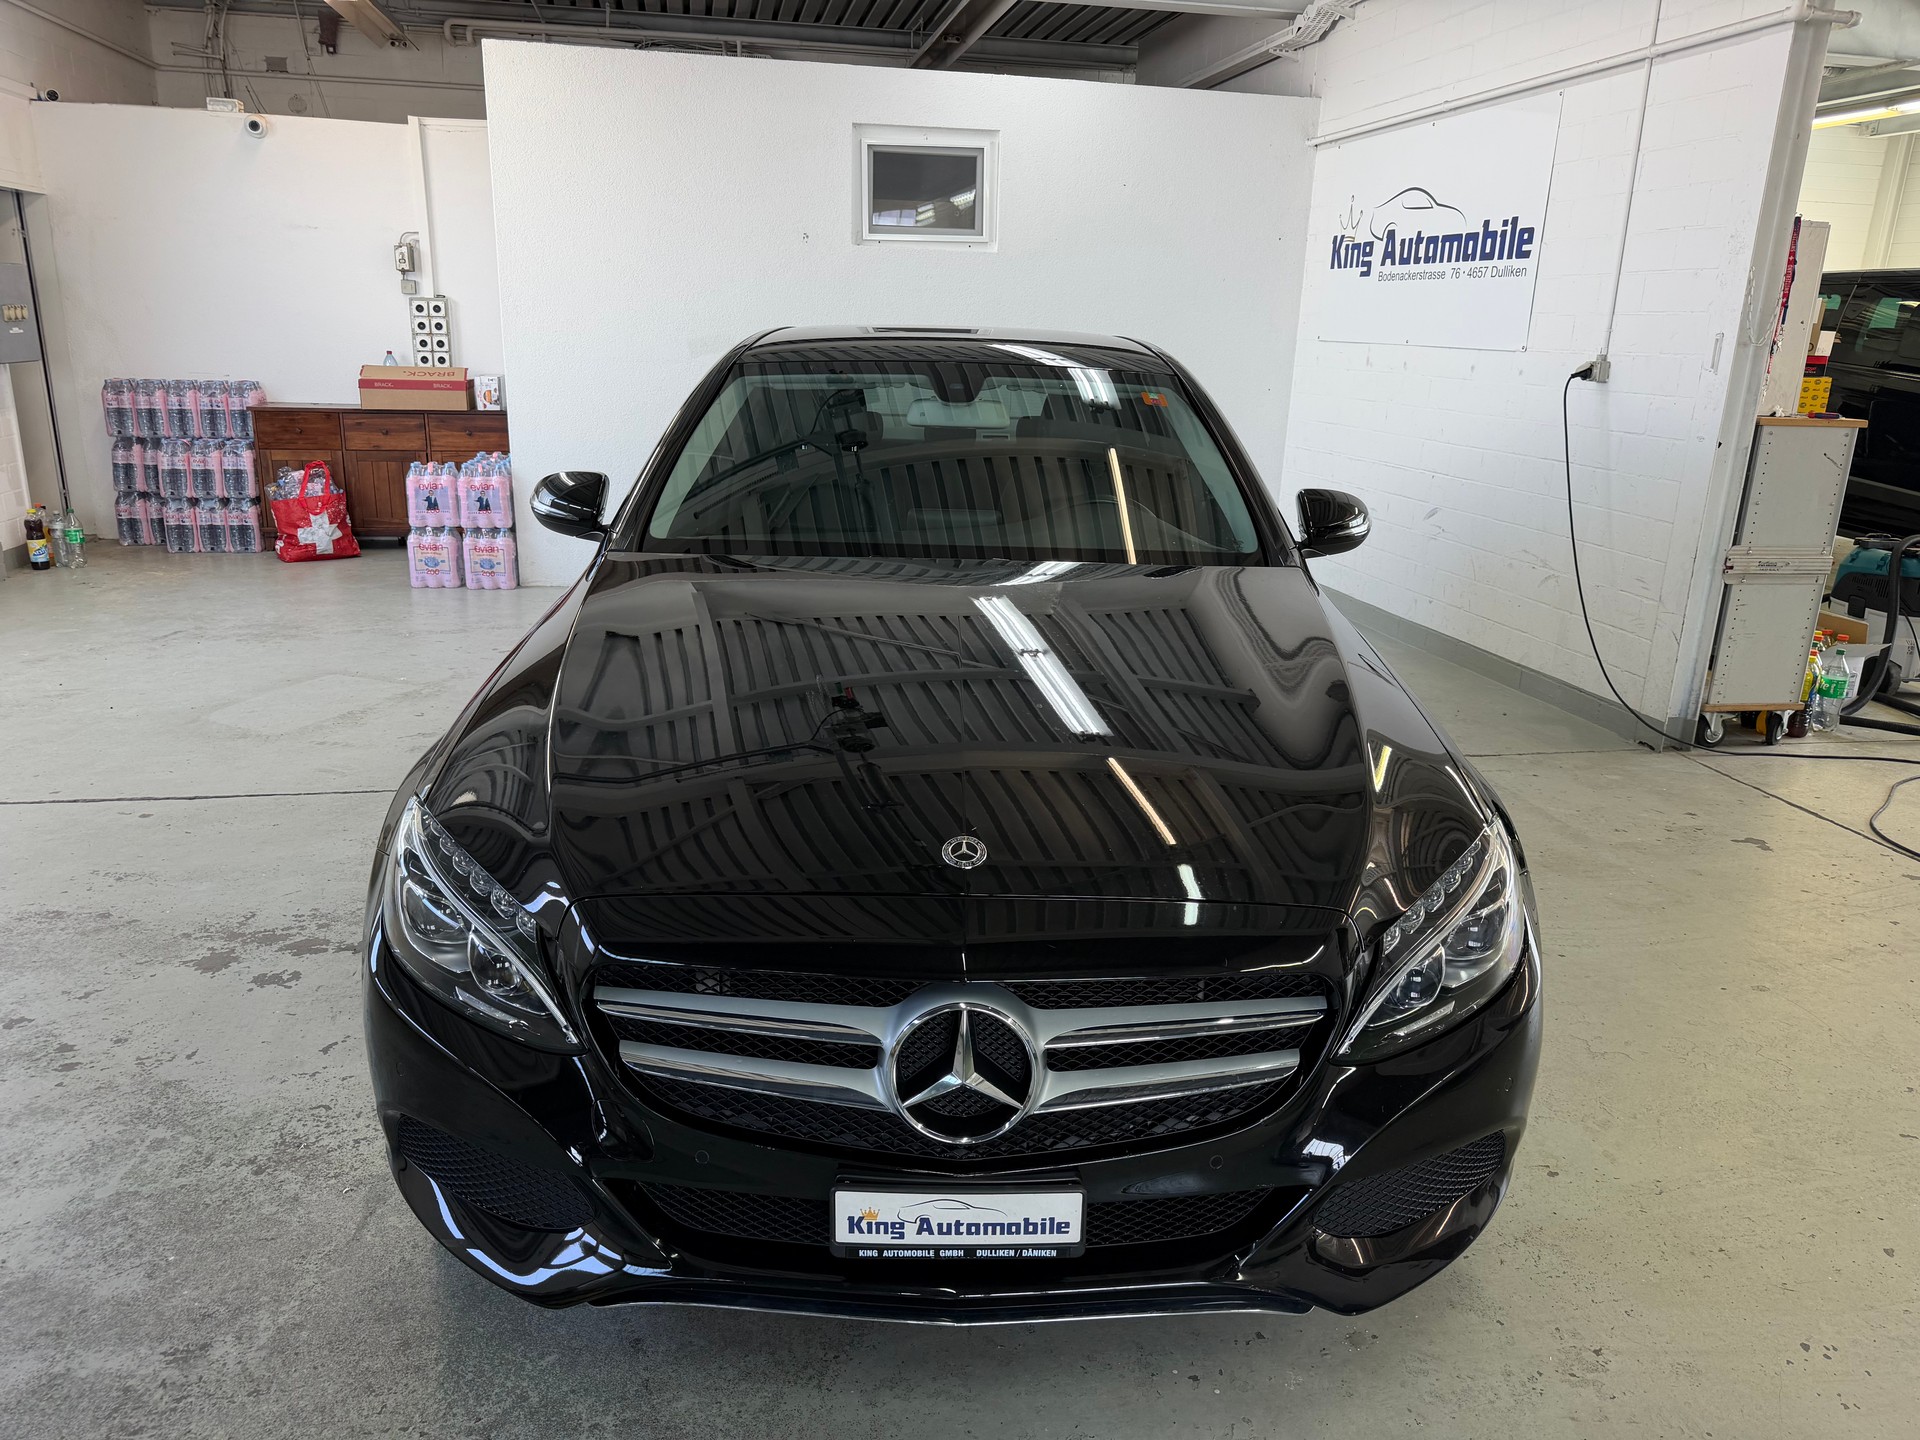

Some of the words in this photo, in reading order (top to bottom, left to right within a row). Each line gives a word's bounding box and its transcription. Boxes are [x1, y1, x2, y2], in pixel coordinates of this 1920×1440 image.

[1330, 234, 1375, 277] King
[1380, 216, 1535, 267] Automobile
[1378, 270, 1446, 282] Bodenackerstrasse
[1450, 268, 1461, 279] 76
[1467, 267, 1489, 279] 4657
[1490, 265, 1527, 278] Dulliken
[419, 481, 444, 491] evian
[470, 482, 495, 492] evian
[418, 543, 443, 551] evian
[474, 545, 500, 554] evian
[847, 1216, 905, 1240] King
[916, 1217, 1070, 1236] Automobile
[859, 1249, 879, 1257] KING
[883, 1249, 935, 1257] AUTOMOBILE
[940, 1249, 964, 1257] GMBH
[976, 1249, 1015, 1257] DULLIKEN
[1022, 1247, 1057, 1257] DÄNIKEN
